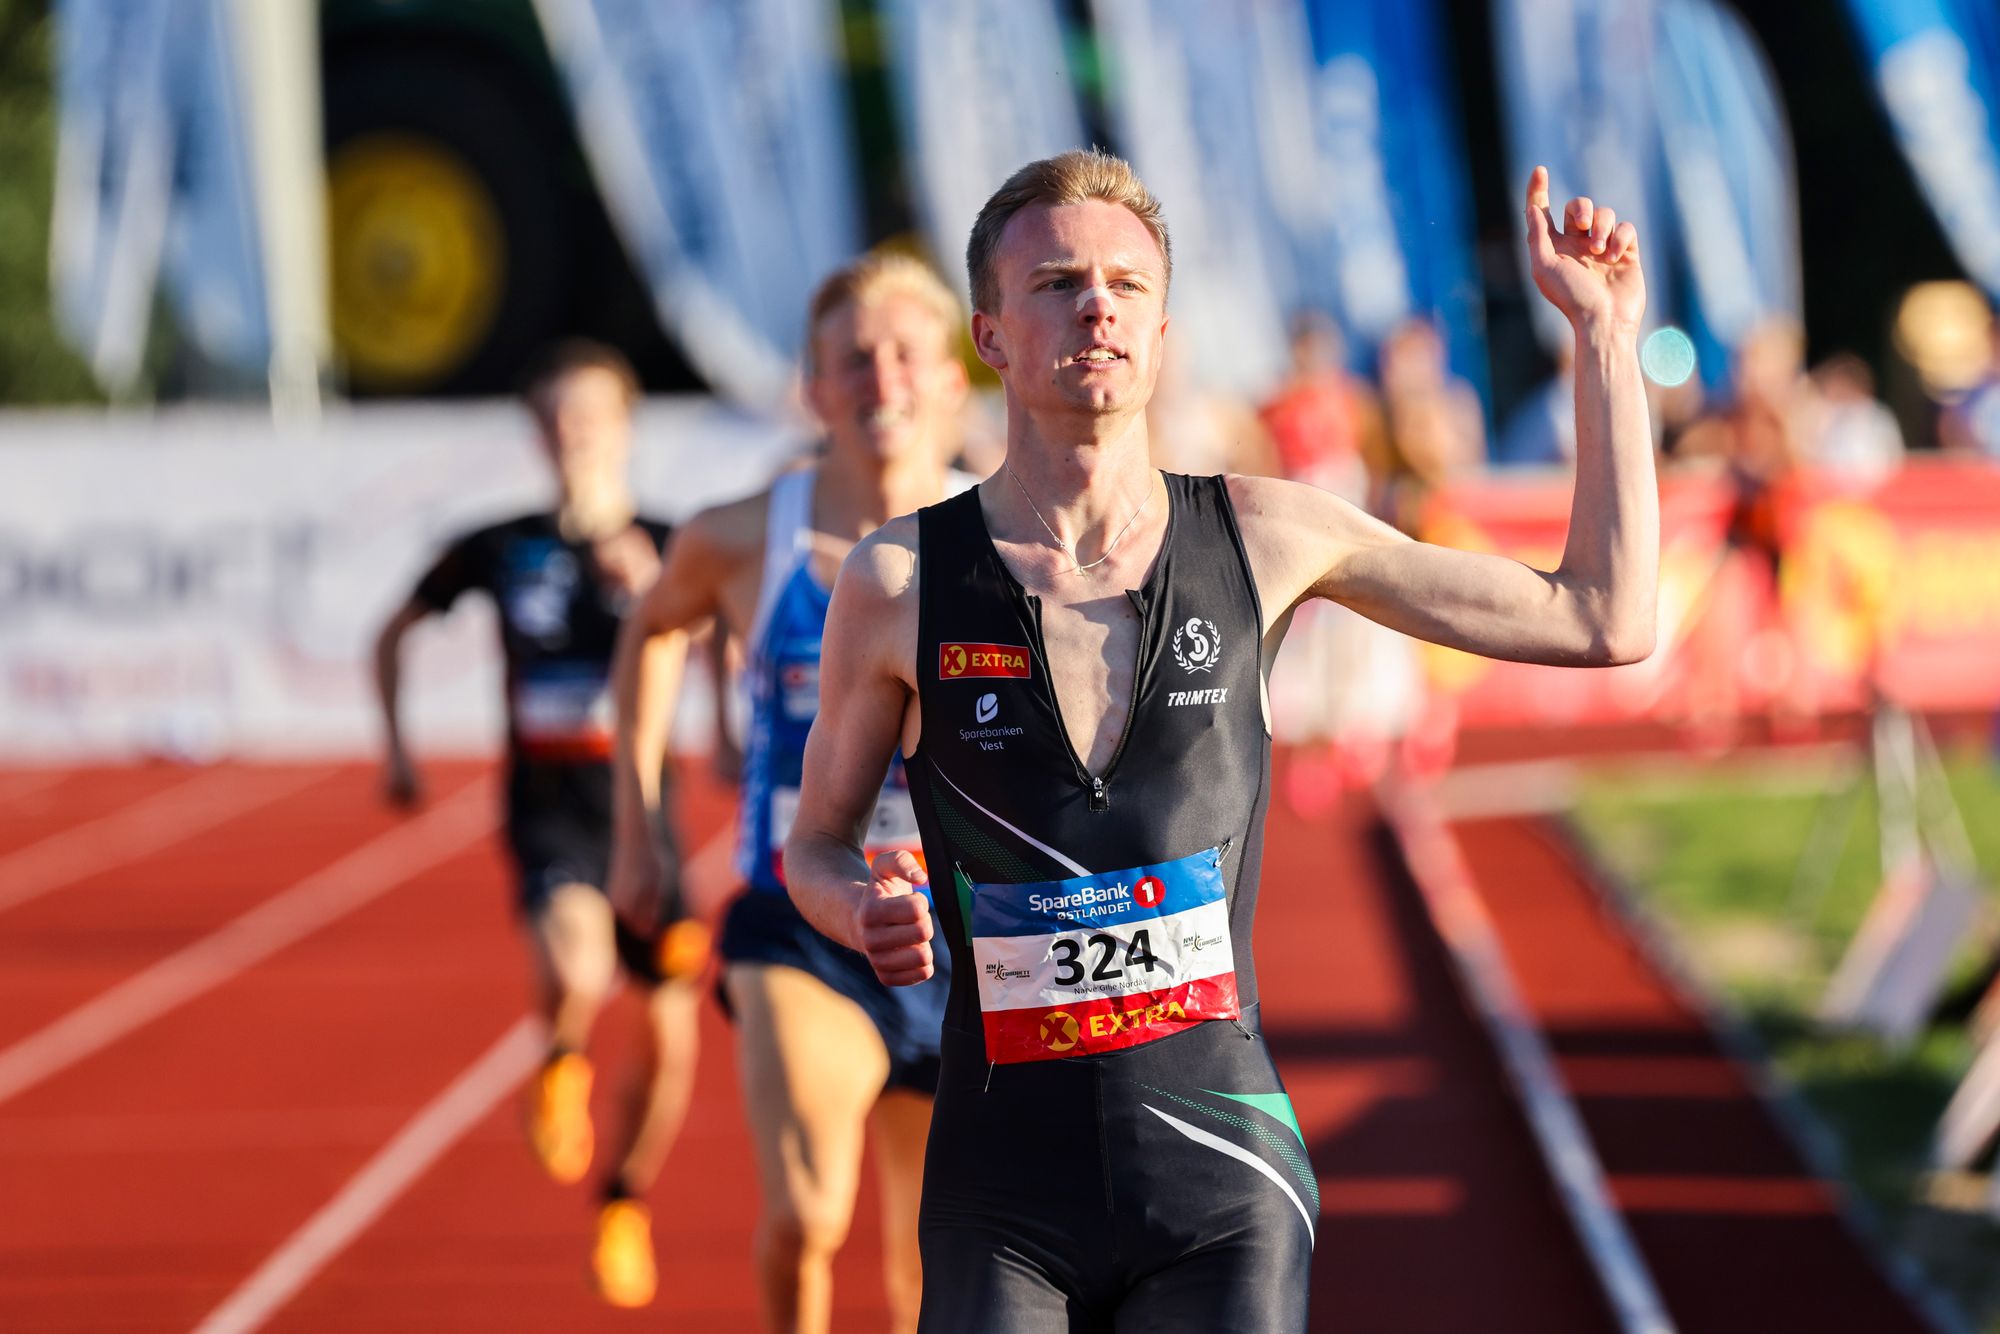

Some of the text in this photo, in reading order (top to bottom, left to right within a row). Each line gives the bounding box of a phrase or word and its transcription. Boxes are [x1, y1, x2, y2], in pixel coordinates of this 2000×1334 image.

[971, 652, 1026, 669] EXTRA
[1167, 687, 1229, 707] TRIMTEX
[959, 725, 1024, 742] Sparebanken
[979, 741, 1005, 751] Vest
[1028, 881, 1156, 913] SpareBank 1
[1057, 901, 1133, 920] ØSTLANDET
[1051, 929, 1159, 986] 324
[1074, 985, 1098, 995] Narve
[1089, 1001, 1187, 1038] EXTRA
